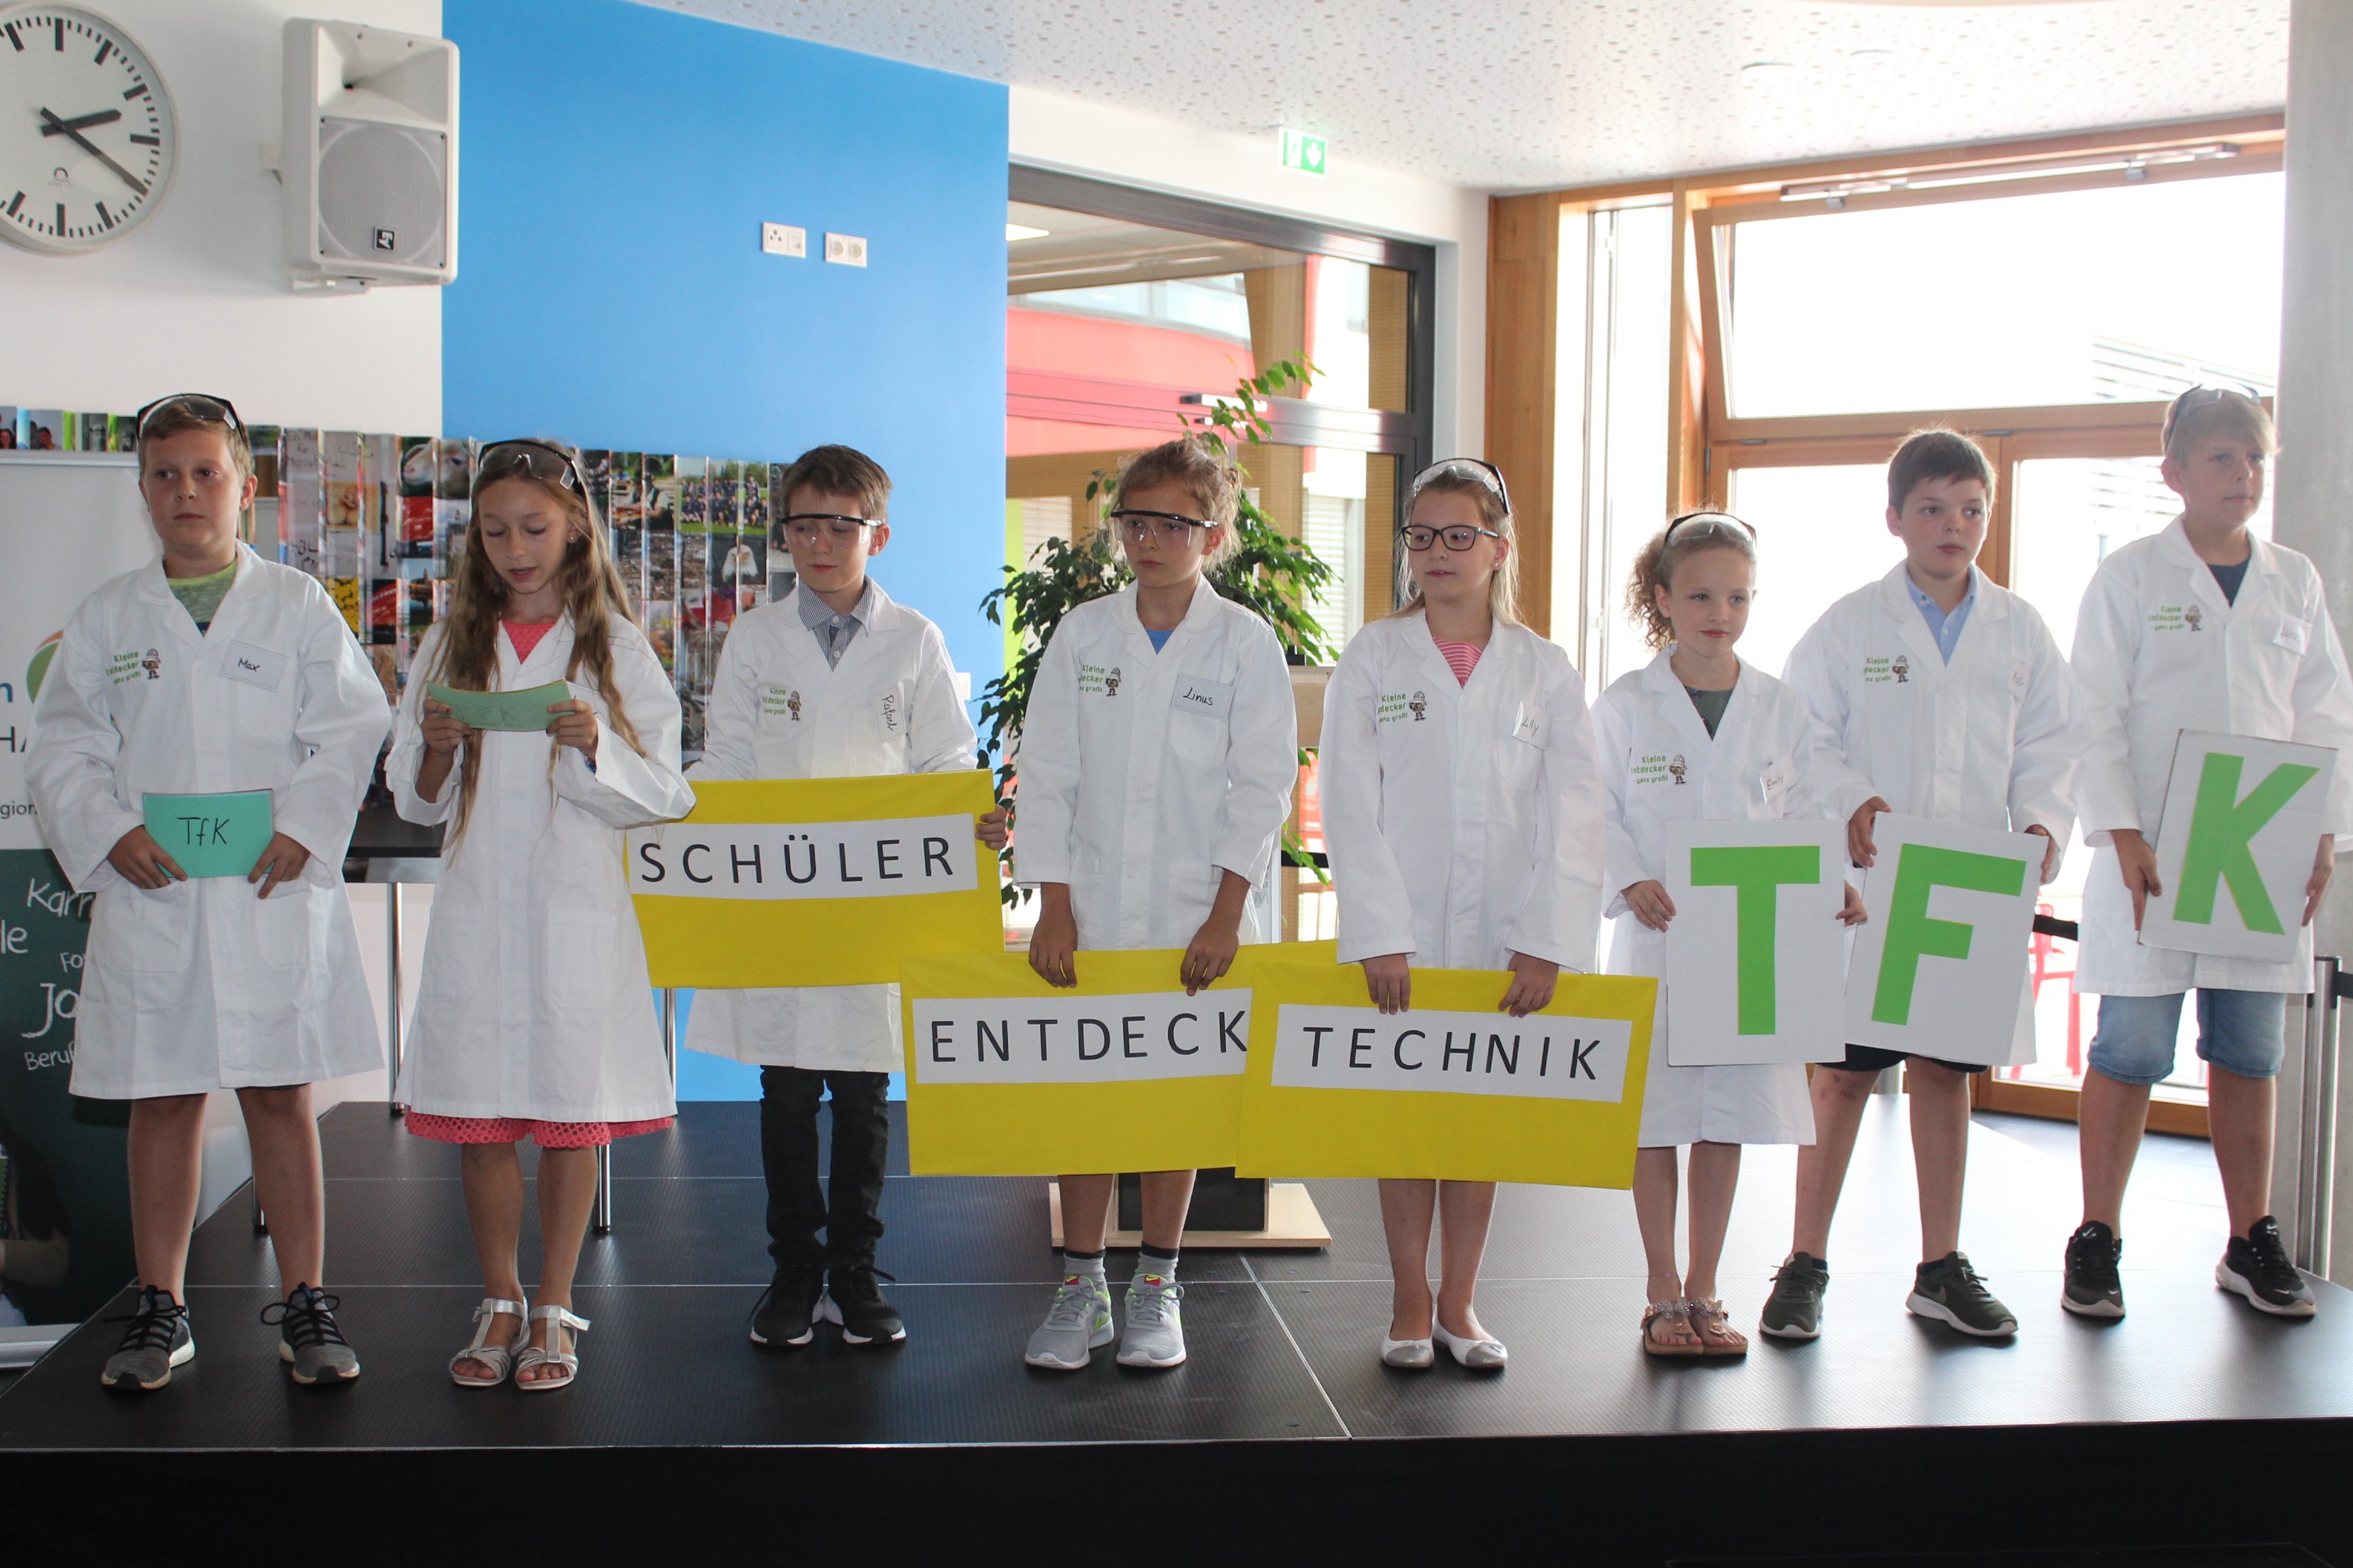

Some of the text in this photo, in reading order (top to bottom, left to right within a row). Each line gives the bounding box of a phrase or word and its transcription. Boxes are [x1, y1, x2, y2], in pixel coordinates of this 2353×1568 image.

[114, 652, 139, 662] Kleine
[238, 658, 260, 672] Max
[1082, 664, 1104, 674] Kleine
[1183, 687, 1213, 705] Linus
[1381, 693, 1406, 702] Kleine
[1391, 712, 1408, 722] groß!
[1642, 755, 1666, 764] Kleine
[1766, 774, 1785, 790] Emily
[177, 817, 229, 846] TfK
[2174, 752, 2319, 935] K
[640, 834, 954, 883] SCHÜLER
[1691, 846, 1820, 1036] T
[1871, 843, 2026, 1026] F
[930, 1010, 1247, 1063] ENTDECK
[1302, 1025, 1601, 1080] TECHNIK
